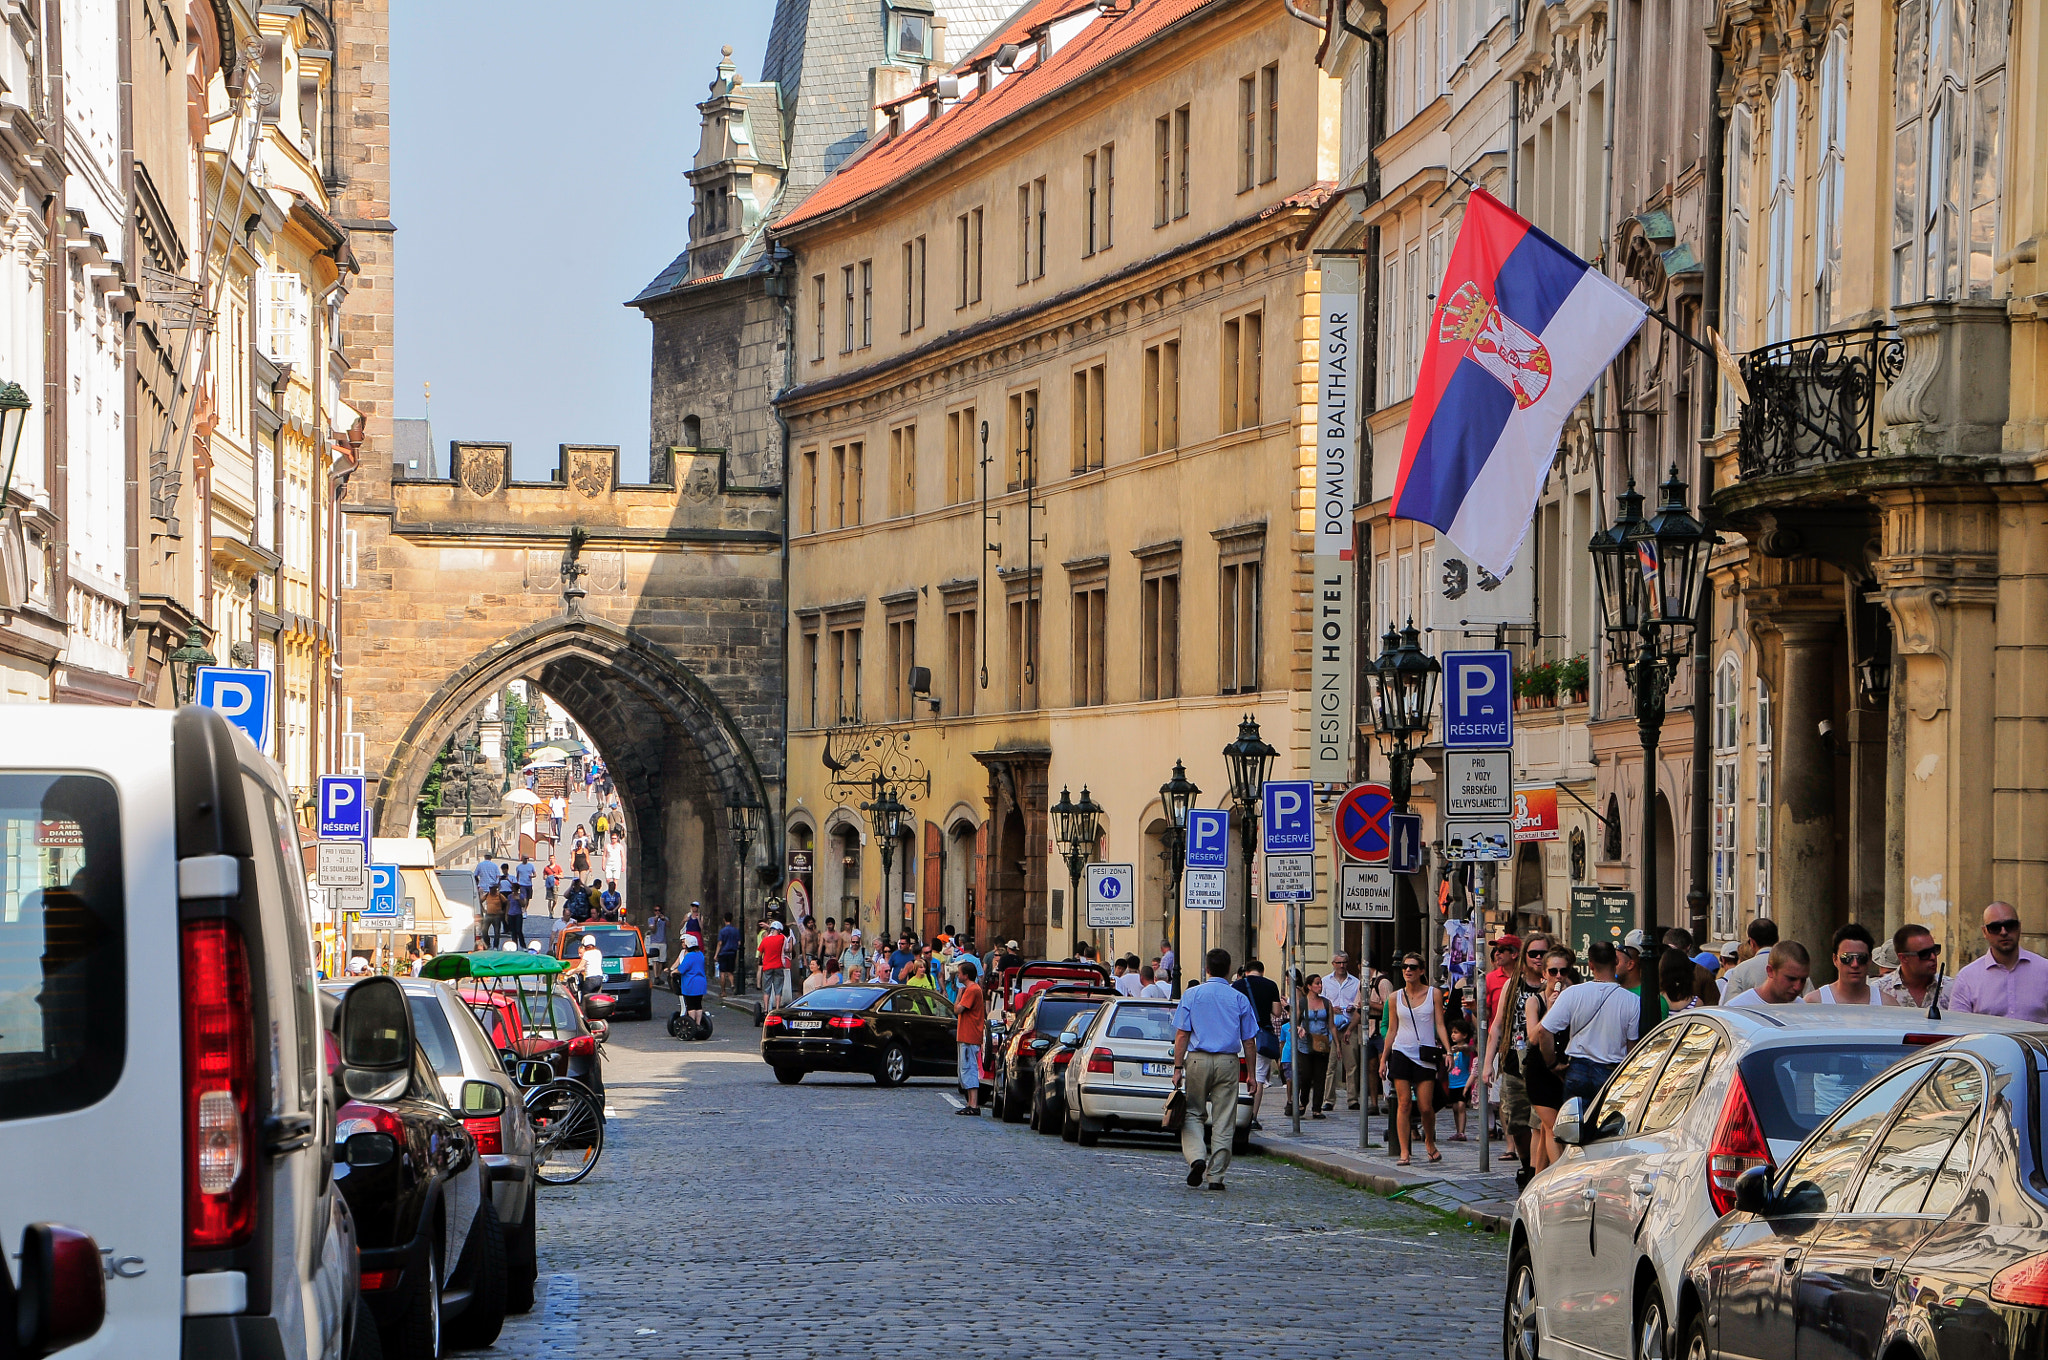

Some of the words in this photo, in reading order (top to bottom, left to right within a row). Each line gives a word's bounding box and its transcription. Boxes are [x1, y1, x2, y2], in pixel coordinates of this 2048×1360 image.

[1327, 312, 1348, 438] BALTHASAR
[1325, 447, 1345, 534] DOMUS
[1322, 574, 1342, 662] HOTEL
[1458, 664, 1496, 716] P
[213, 681, 252, 717] P
[1320, 674, 1340, 760] DESIGN
[1450, 722, 1506, 736] RÉSERVÉ
[1472, 758, 1486, 768] PRO
[1466, 772, 1471, 781] 2
[1474, 772, 1491, 781] VOZY
[1462, 784, 1497, 794] SRBSKÉHO
[329, 783, 355, 819] P
[1451, 796, 1507, 808] VELVYSLANECTÍ
[1274, 791, 1302, 829] P
[323, 822, 359, 831] RÉSERVÉ
[1512, 814, 1542, 830] gend
[1196, 818, 1219, 848] P
[1268, 833, 1310, 843] RÉSERVÉ
[1190, 852, 1224, 861] RÉSERVÉ
[371, 870, 390, 899] P
[1358, 874, 1379, 883] MIMO
[1347, 886, 1391, 897] ZÁSOBOVÁNÍ
[1345, 902, 1362, 911] MAX.
[1375, 903, 1390, 911] min.
[1603, 897, 1628, 906] Tullamore
[1152, 1064, 1167, 1073] 1AR
